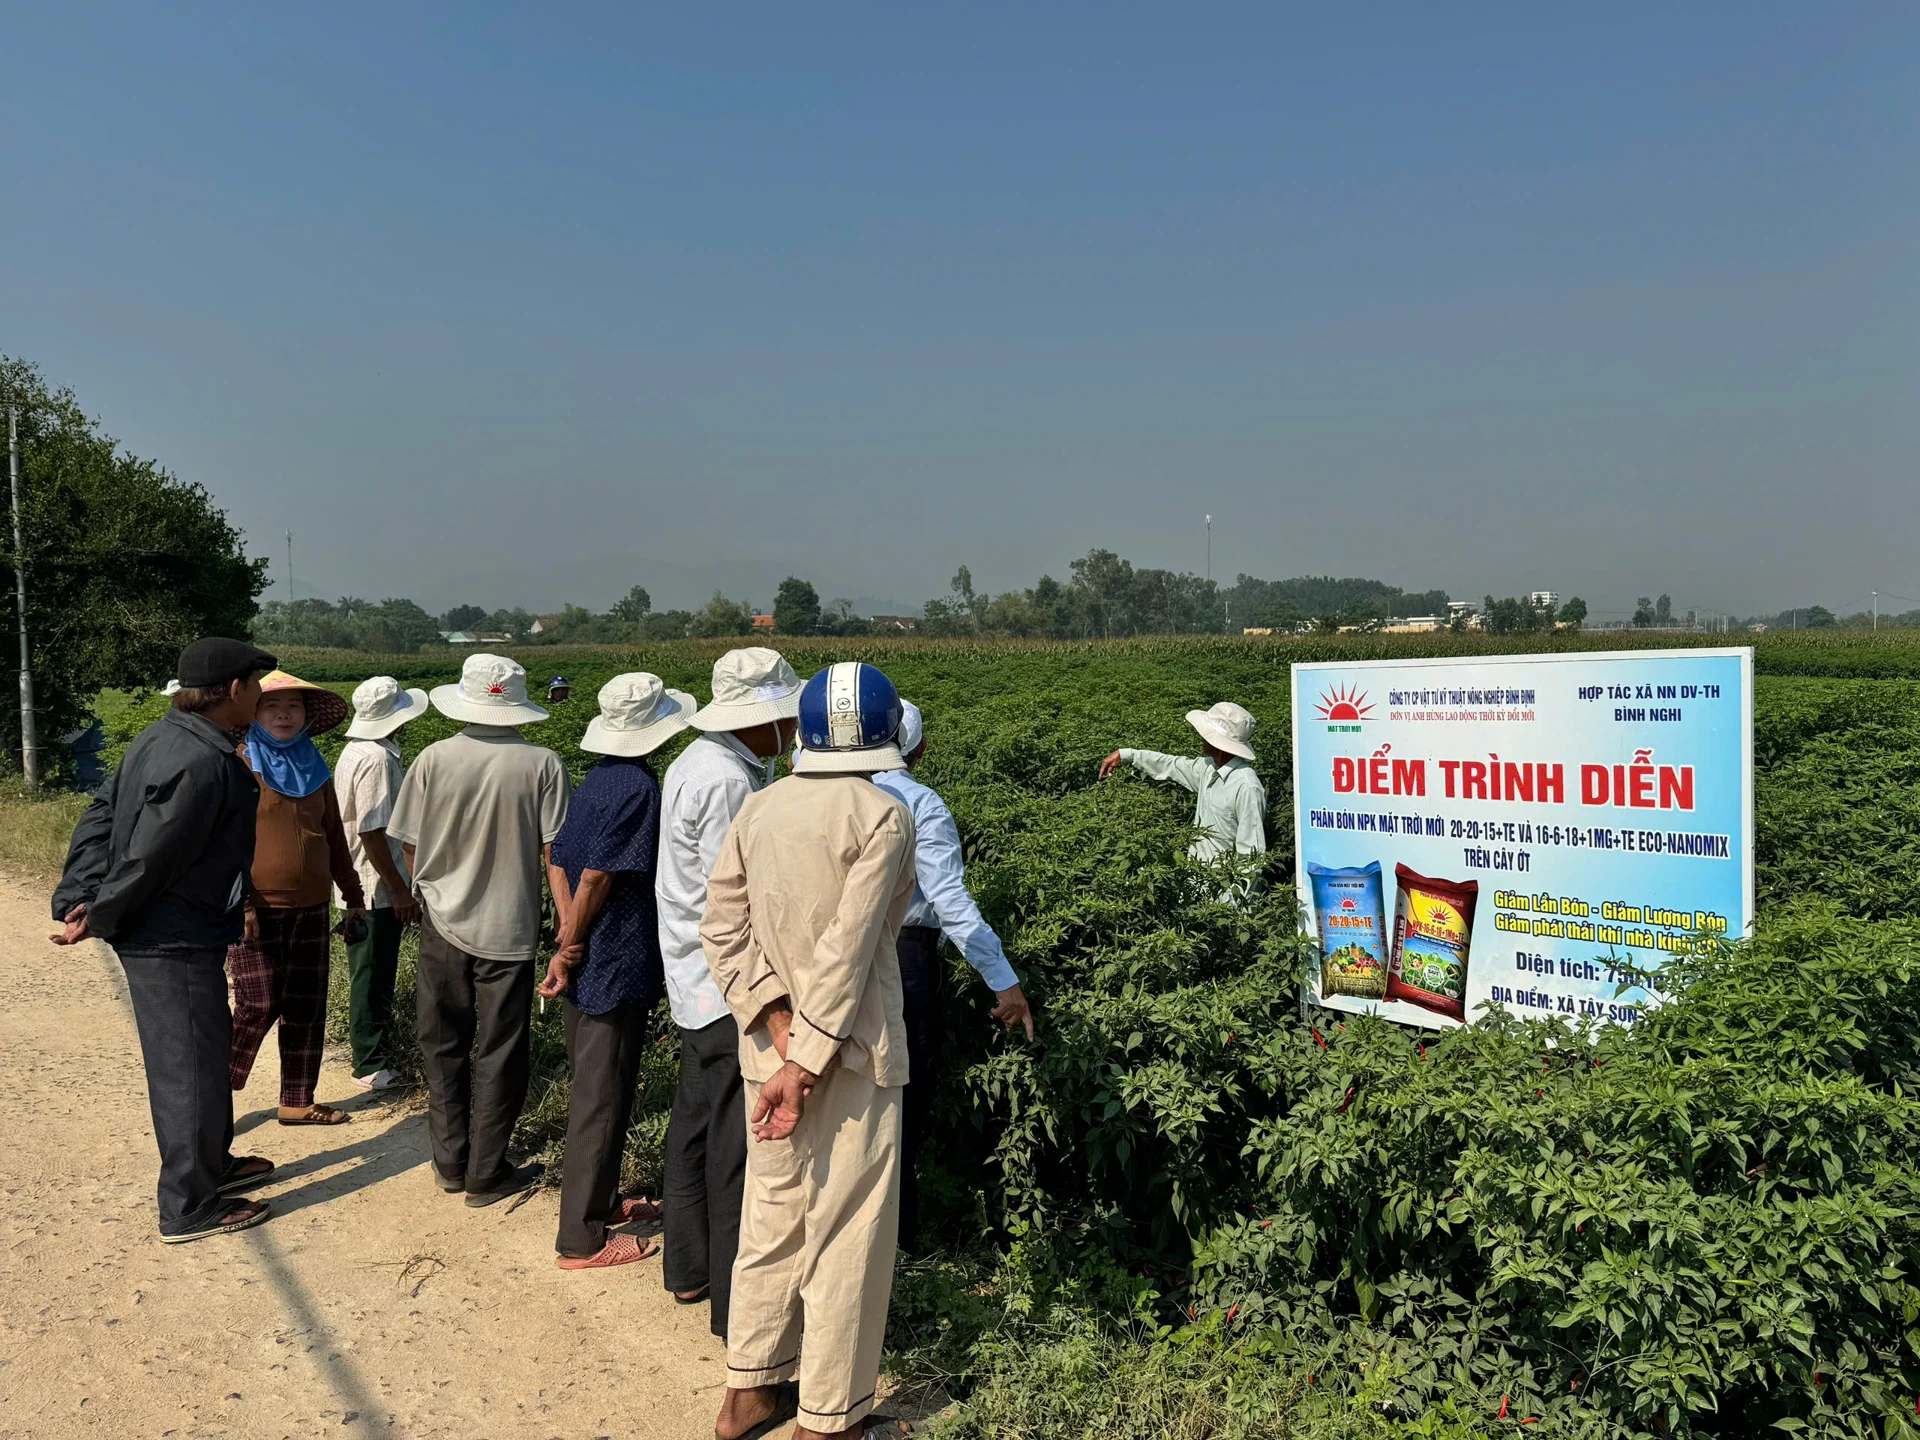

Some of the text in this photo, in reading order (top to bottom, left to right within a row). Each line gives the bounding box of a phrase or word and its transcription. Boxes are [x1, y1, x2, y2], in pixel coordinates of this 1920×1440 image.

[1404, 691, 1411, 705] TY
[1412, 691, 1419, 705] CP
[1579, 684, 1720, 702] HỢP TÁC XÃ NN DV-TH
[1412, 711, 1425, 721] ANH
[1445, 711, 1458, 721] LAO
[1615, 706, 1682, 721] BÌNH NGHI
[1332, 743, 1694, 810] ĐIỂM TRÌNH DIỄN
[1310, 808, 1729, 858] PHÂN BÓN NPK MẶT TRỜI MỚI 20-20-15+TE VÀ 16-6-18+1MG+TE ECO-NANOMIX
[1464, 846, 1530, 872] TRÊN CÂY ỚT
[1494, 890, 1530, 911] Giảm
[1532, 892, 1559, 914] Lần
[1561, 896, 1589, 917] Bón
[1602, 901, 1641, 923] Giảm
[1644, 905, 1692, 931] Lượng
[1495, 913, 1530, 934] Giảm
[1533, 917, 1564, 938] phát
[1566, 921, 1595, 942] thải
[1598, 924, 1622, 945] khí
[1625, 928, 1655, 949] nhà
[1516, 951, 1554, 977] Diện
[1560, 957, 1600, 981] tích:
[1516, 986, 1553, 1010] ĐIỂM:
[1557, 995, 1575, 1014] XÃ
